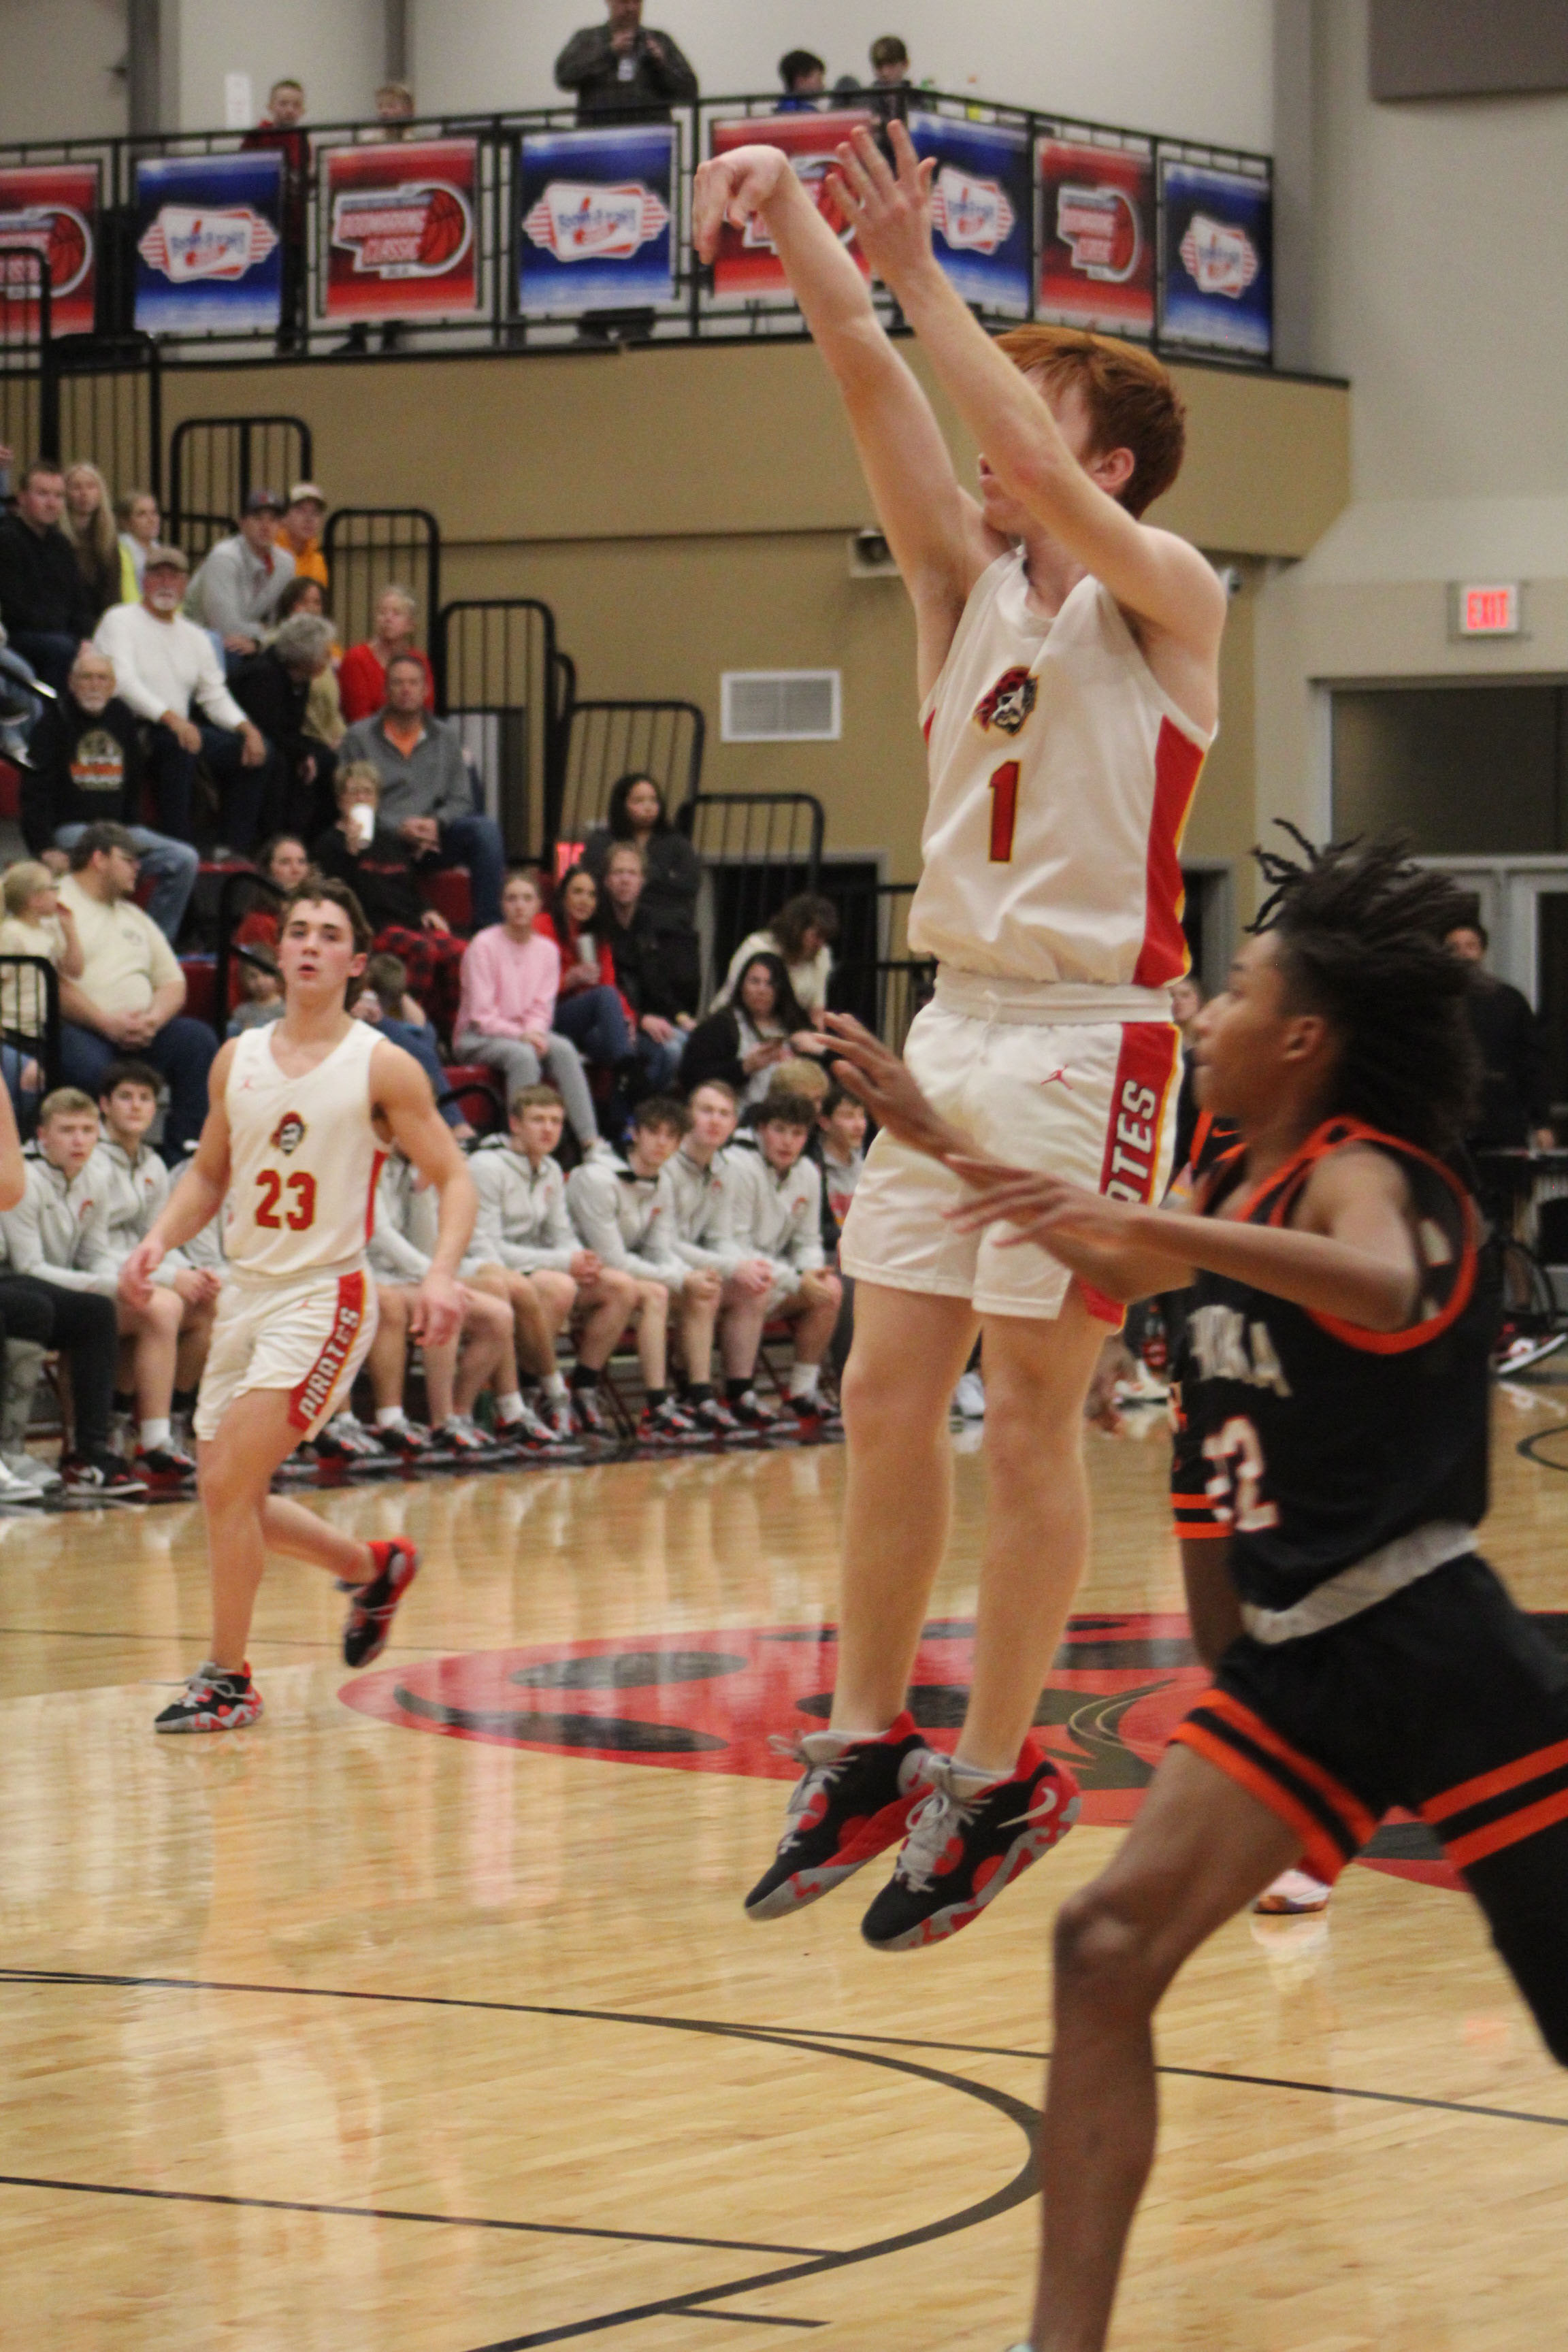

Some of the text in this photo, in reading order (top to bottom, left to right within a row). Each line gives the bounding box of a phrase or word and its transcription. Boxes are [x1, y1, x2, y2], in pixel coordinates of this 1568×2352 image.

[1467, 591, 1508, 630] EXIT
[989, 760, 1021, 863] 1
[255, 1169, 316, 1231] 23
[298, 1306, 360, 1421] PIRATES
